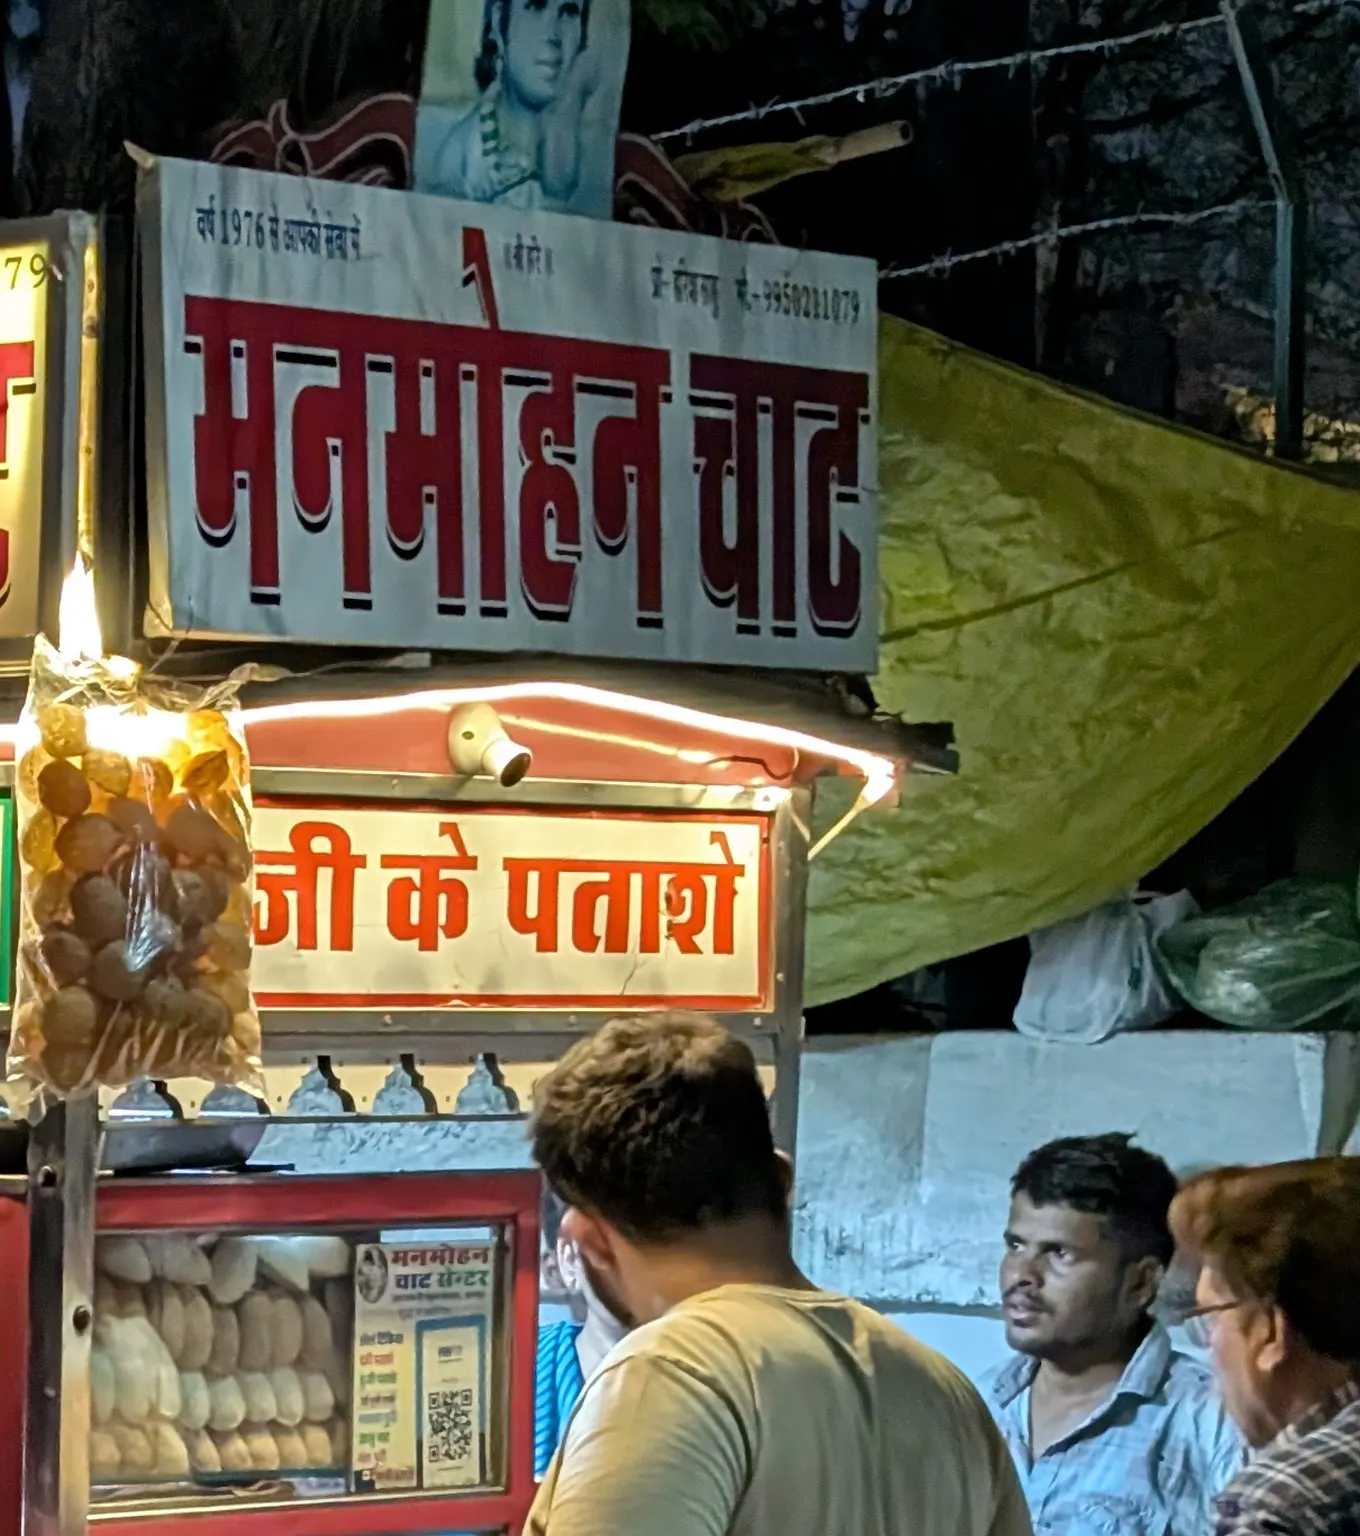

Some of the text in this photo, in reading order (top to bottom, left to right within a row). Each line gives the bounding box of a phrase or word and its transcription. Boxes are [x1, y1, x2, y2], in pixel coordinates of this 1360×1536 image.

[220, 208, 265, 249] 1976
[184, 226, 871, 638] मनमोहन चाट
[380, 821, 478, 952] के
[502, 831, 746, 955] पताशे
